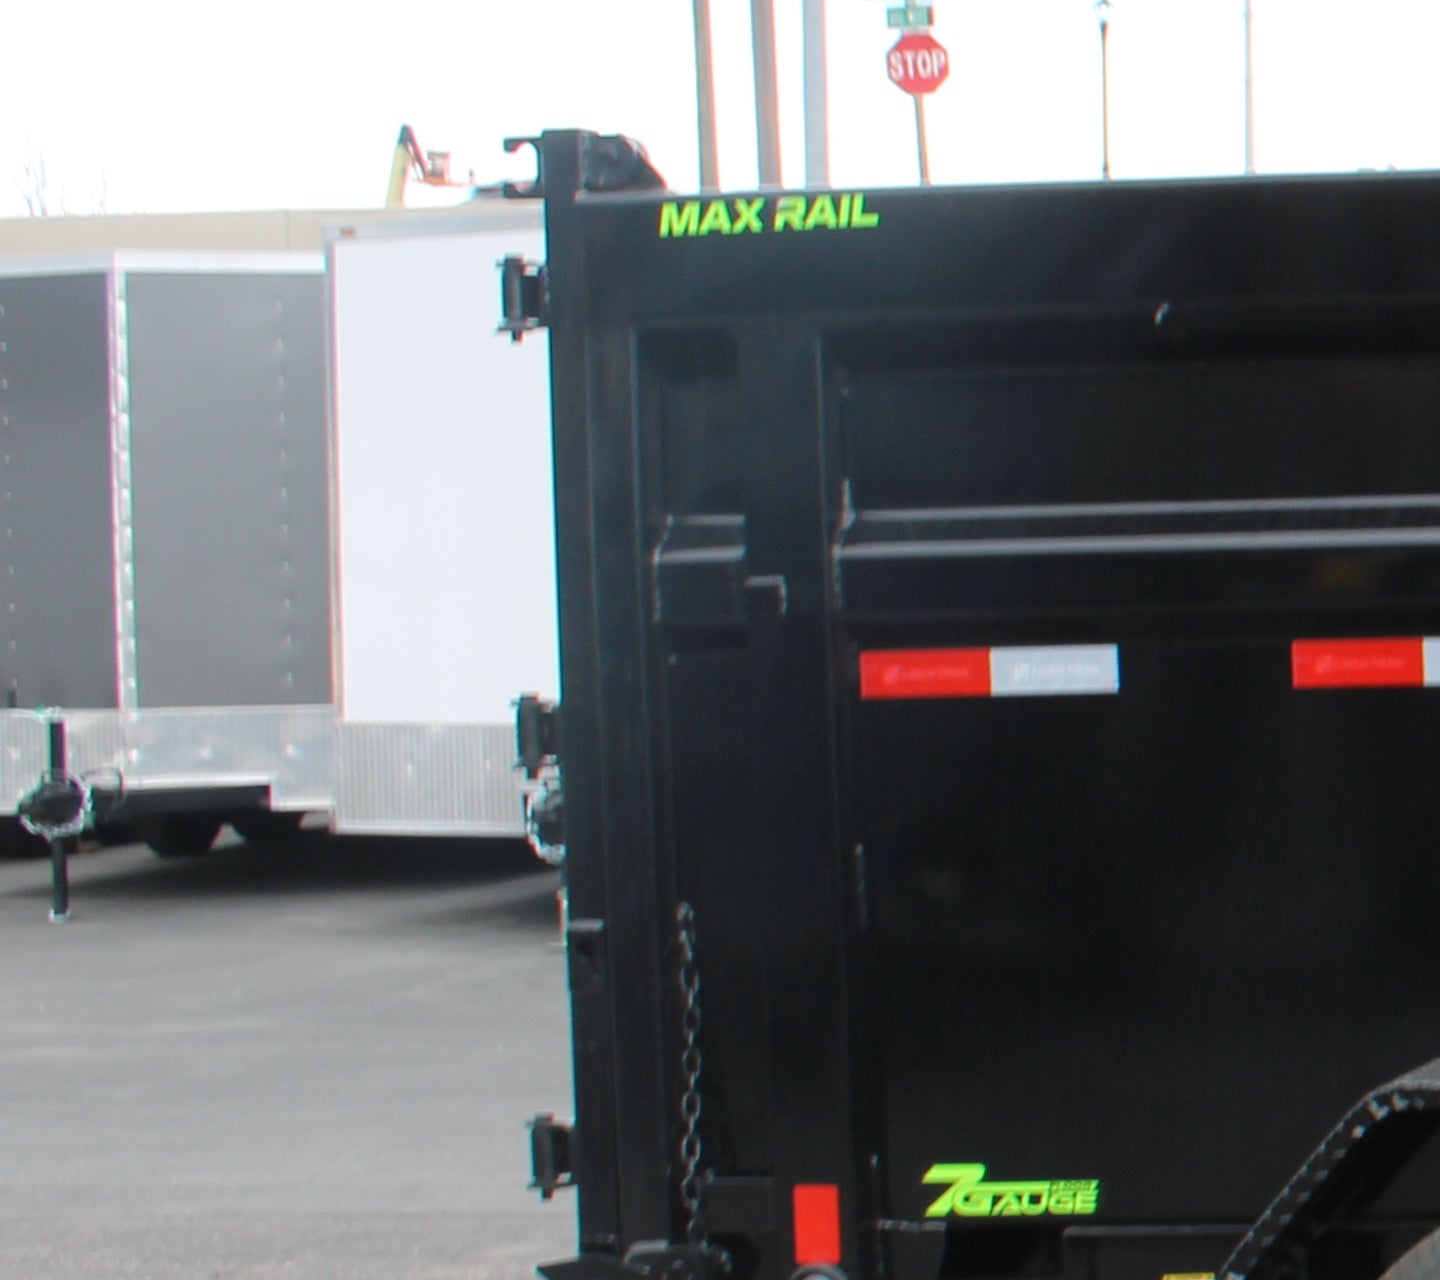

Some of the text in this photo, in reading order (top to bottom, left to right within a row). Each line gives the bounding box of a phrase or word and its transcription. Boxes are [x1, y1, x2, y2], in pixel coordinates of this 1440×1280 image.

[889, 49, 946, 80] STOP
[659, 193, 879, 238] MAX RAIL
